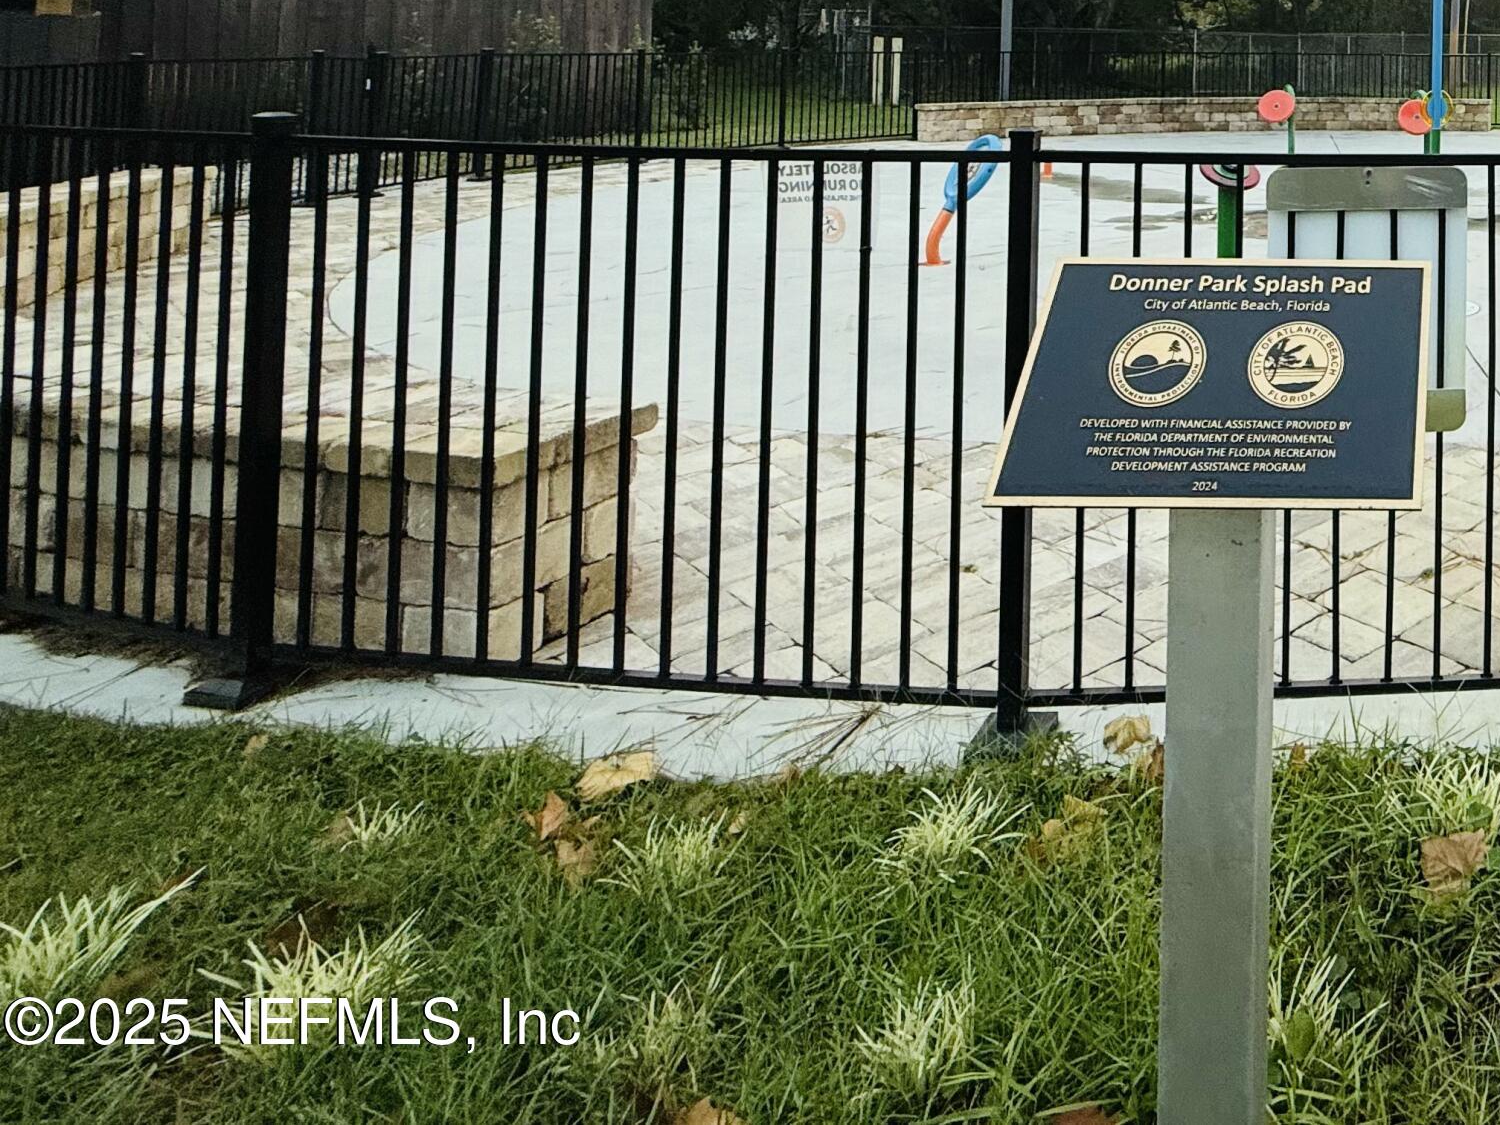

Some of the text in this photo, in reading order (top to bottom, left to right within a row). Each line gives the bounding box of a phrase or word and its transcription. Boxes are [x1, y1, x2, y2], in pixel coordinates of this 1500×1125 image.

[1109, 274, 1372, 296] Donner Park Splash Pad
[1144, 298, 1331, 312] City of Atlantic Beach, Florida
[1120, 325, 1201, 355] FLORIDA DEPARTMENT OF
[1253, 325, 1340, 376] CITY OF ATLANTIC BEACH
[1114, 363, 1199, 401] ENVIRONMENTAL PROTECTION
[1267, 390, 1317, 403] FLORIDA
[1080, 418, 1352, 431] DEVELOPED WITH FINANCIAL ASSISTANCE PROVIDED BY
[1094, 432, 1334, 444] THE FLORIDA DEPARTMENT OF ENVIRONMENTAL
[1086, 446, 1337, 458] PROTECTION THROUGH THE FLORIDA RECREATION
[1111, 461, 1306, 473] DEVELOPMENT ASSISTANCE PROGRAM
[1192, 481, 1218, 491] 2024
